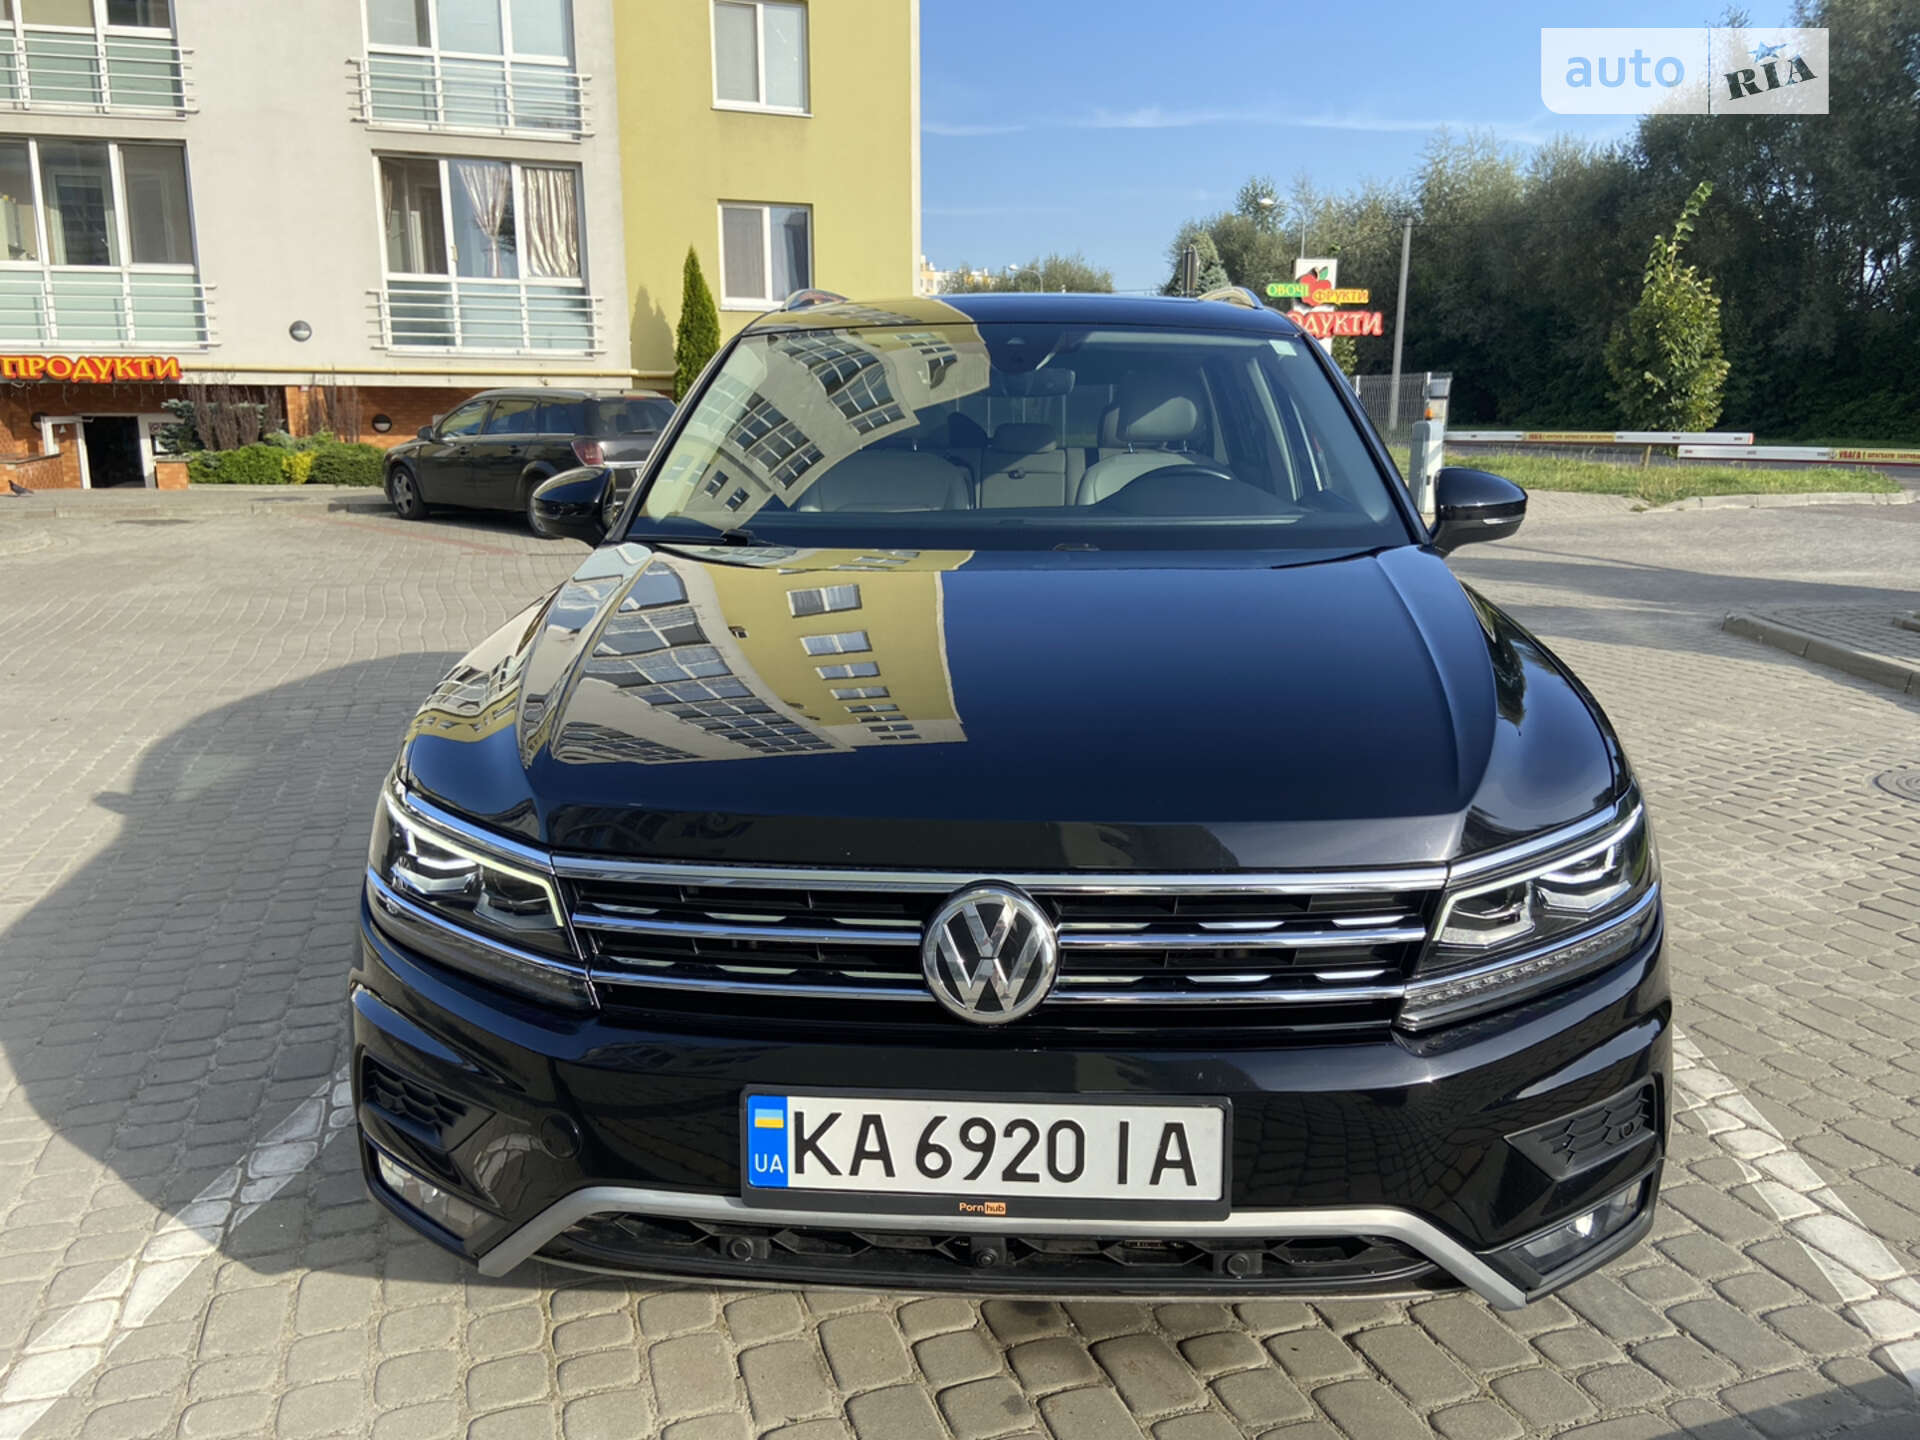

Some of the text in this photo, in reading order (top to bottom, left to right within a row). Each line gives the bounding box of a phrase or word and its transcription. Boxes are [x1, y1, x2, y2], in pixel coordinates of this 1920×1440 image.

[1267, 284, 1309, 297] ОВОЧІ
[1312, 290, 1369, 304] ФРУКТИ
[1, 356, 181, 381] ПРОДУКТИ
[793, 1110, 1198, 1186] KA 6920 IA
[754, 1153, 784, 1174] UA
